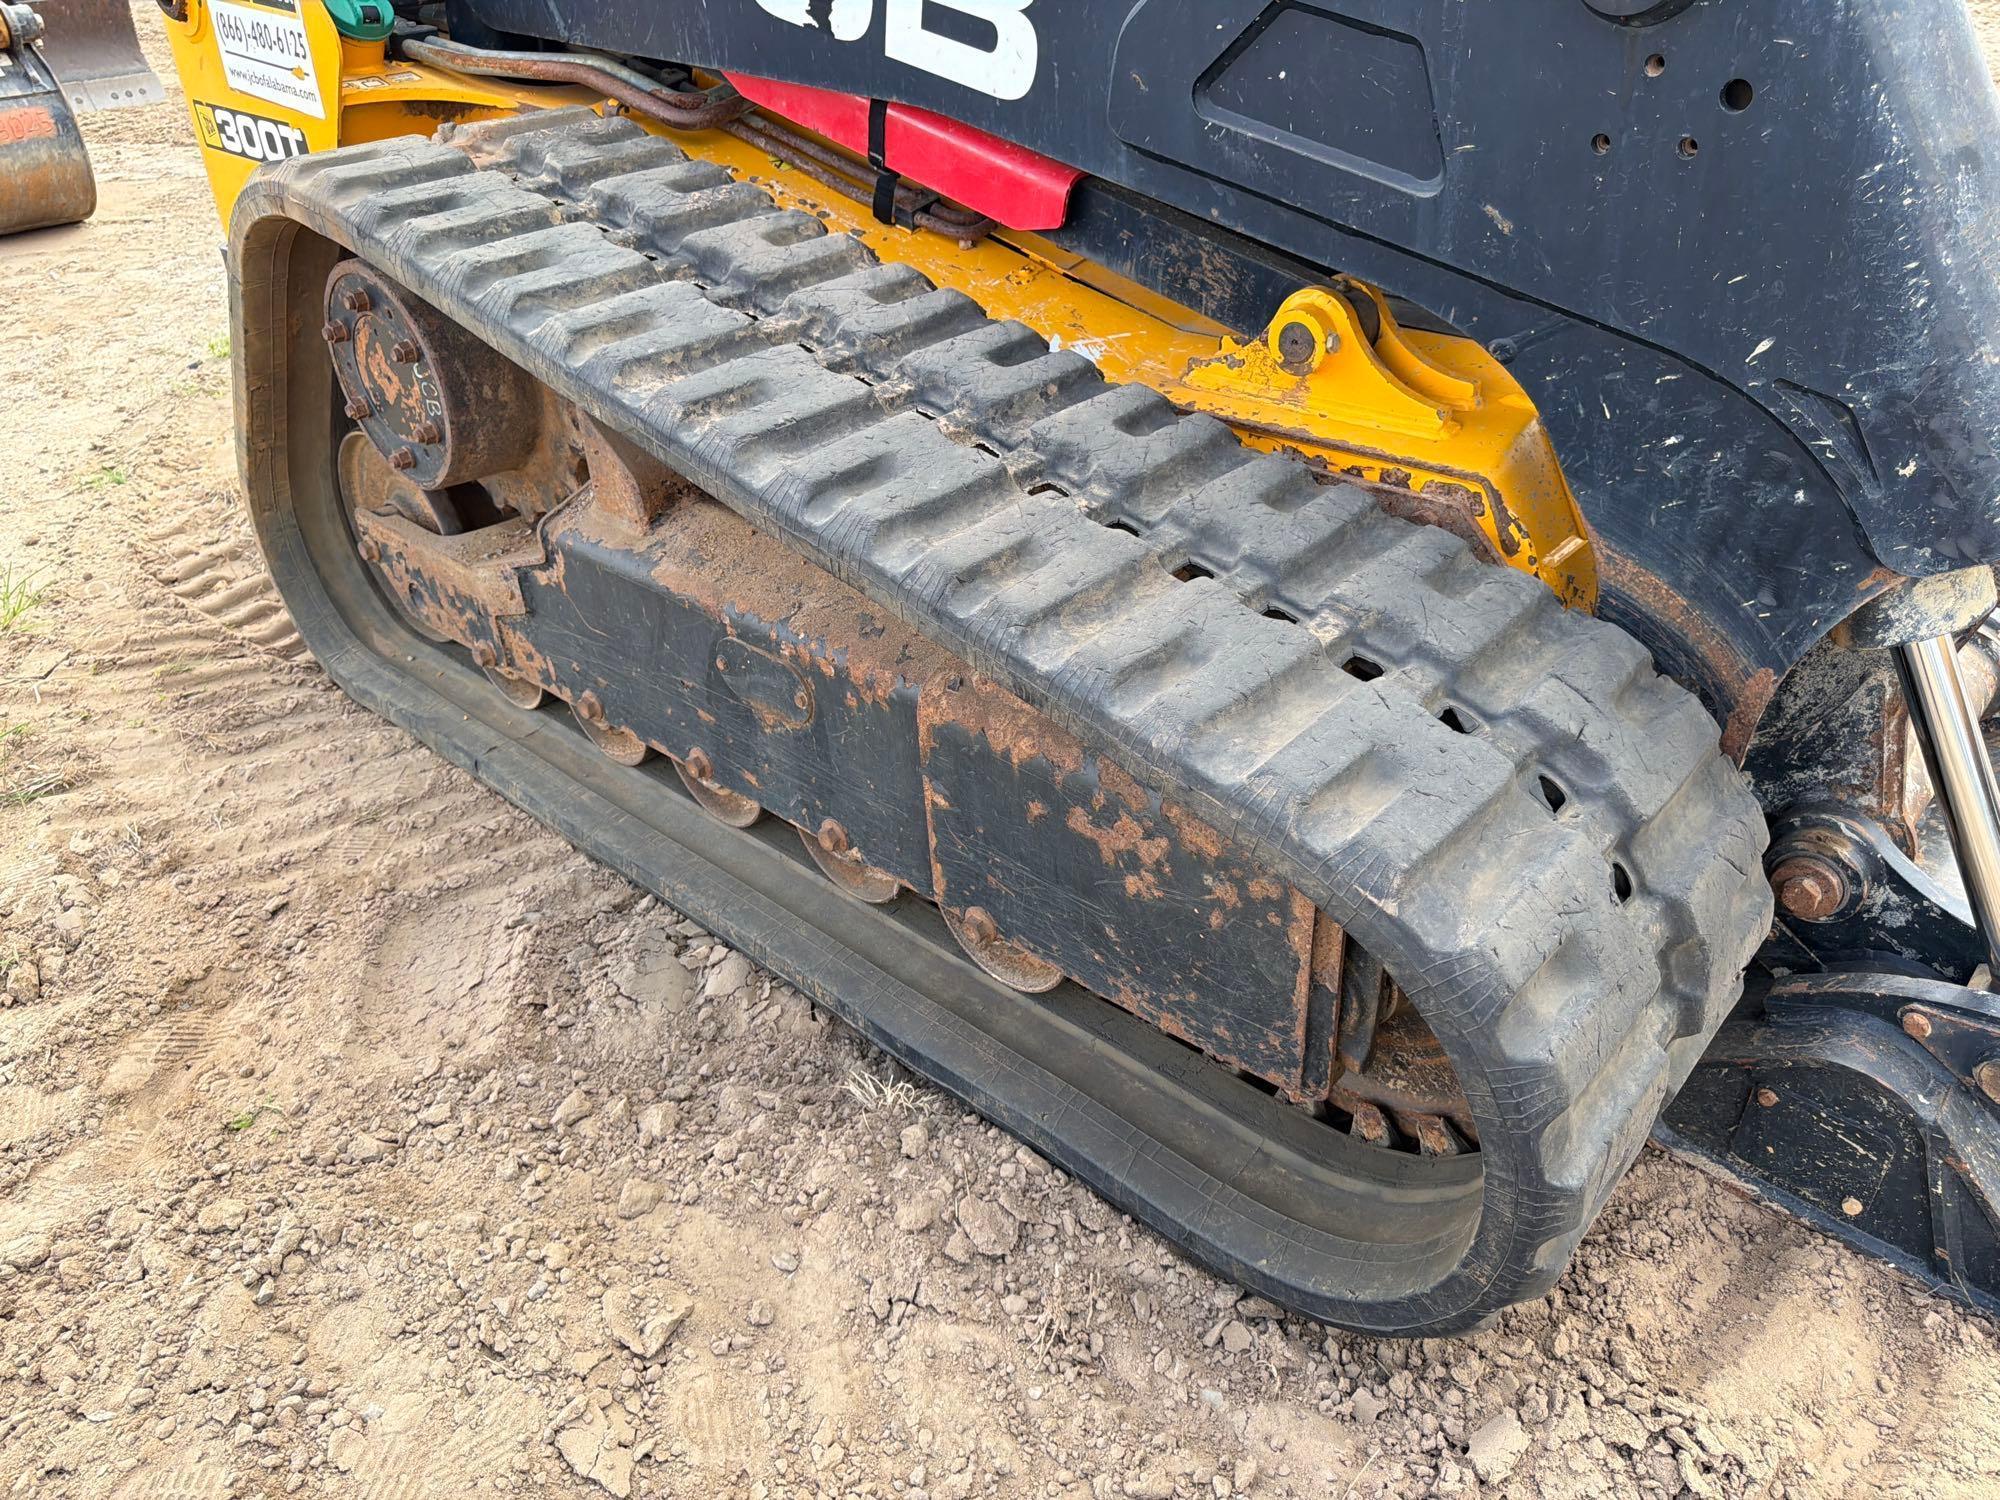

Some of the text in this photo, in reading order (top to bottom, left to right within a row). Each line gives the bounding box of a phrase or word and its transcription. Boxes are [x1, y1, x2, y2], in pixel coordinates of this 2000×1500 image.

[217, 12, 306, 59] (866)-480-6125
[230, 67, 316, 102] www.jcbofalabama.com
[215, 109, 302, 161] 300T
[413, 362, 441, 416] JCB
